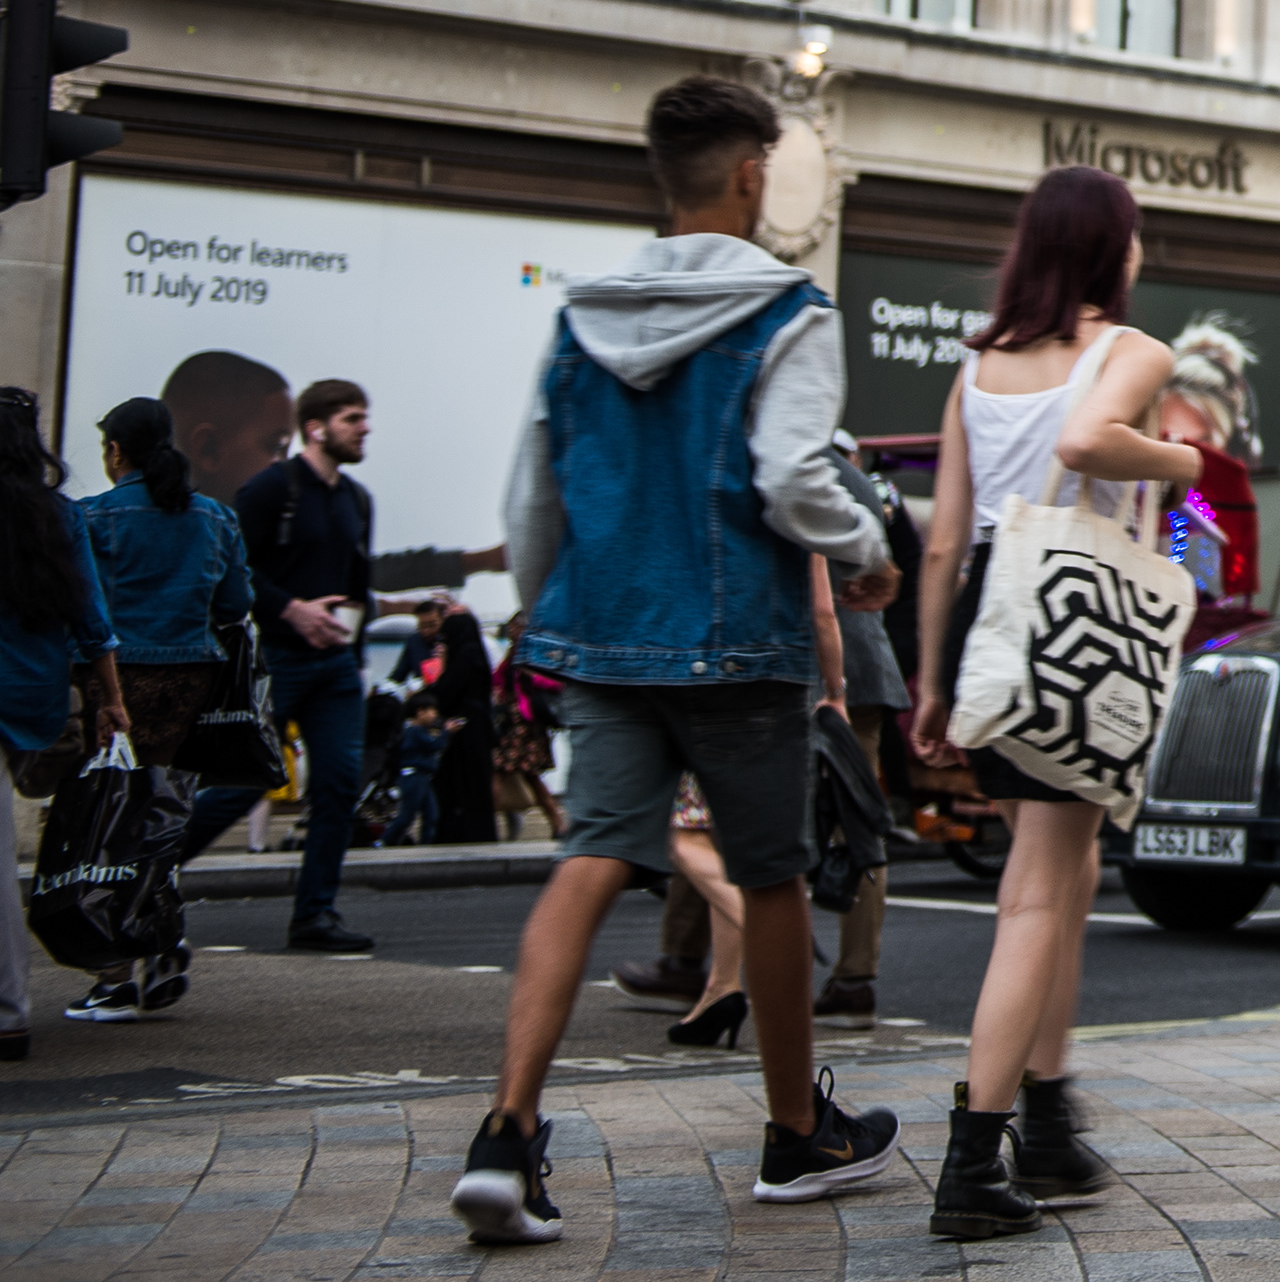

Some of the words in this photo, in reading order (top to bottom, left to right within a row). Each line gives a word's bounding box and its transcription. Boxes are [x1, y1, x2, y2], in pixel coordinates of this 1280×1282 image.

[1042, 120, 1249, 194] Microsoft
[125, 229, 199, 265] Open
[206, 234, 245, 264] for
[250, 238, 349, 274] learners
[124, 270, 146, 296] 11
[151, 272, 205, 308] July
[208, 275, 269, 306] 2019
[871, 296, 929, 331] Open
[930, 299, 961, 330] for
[870, 331, 890, 359] 11
[891, 333, 933, 368] July
[933, 335, 968, 364] 201
[1193, 828, 1236, 859] LBK
